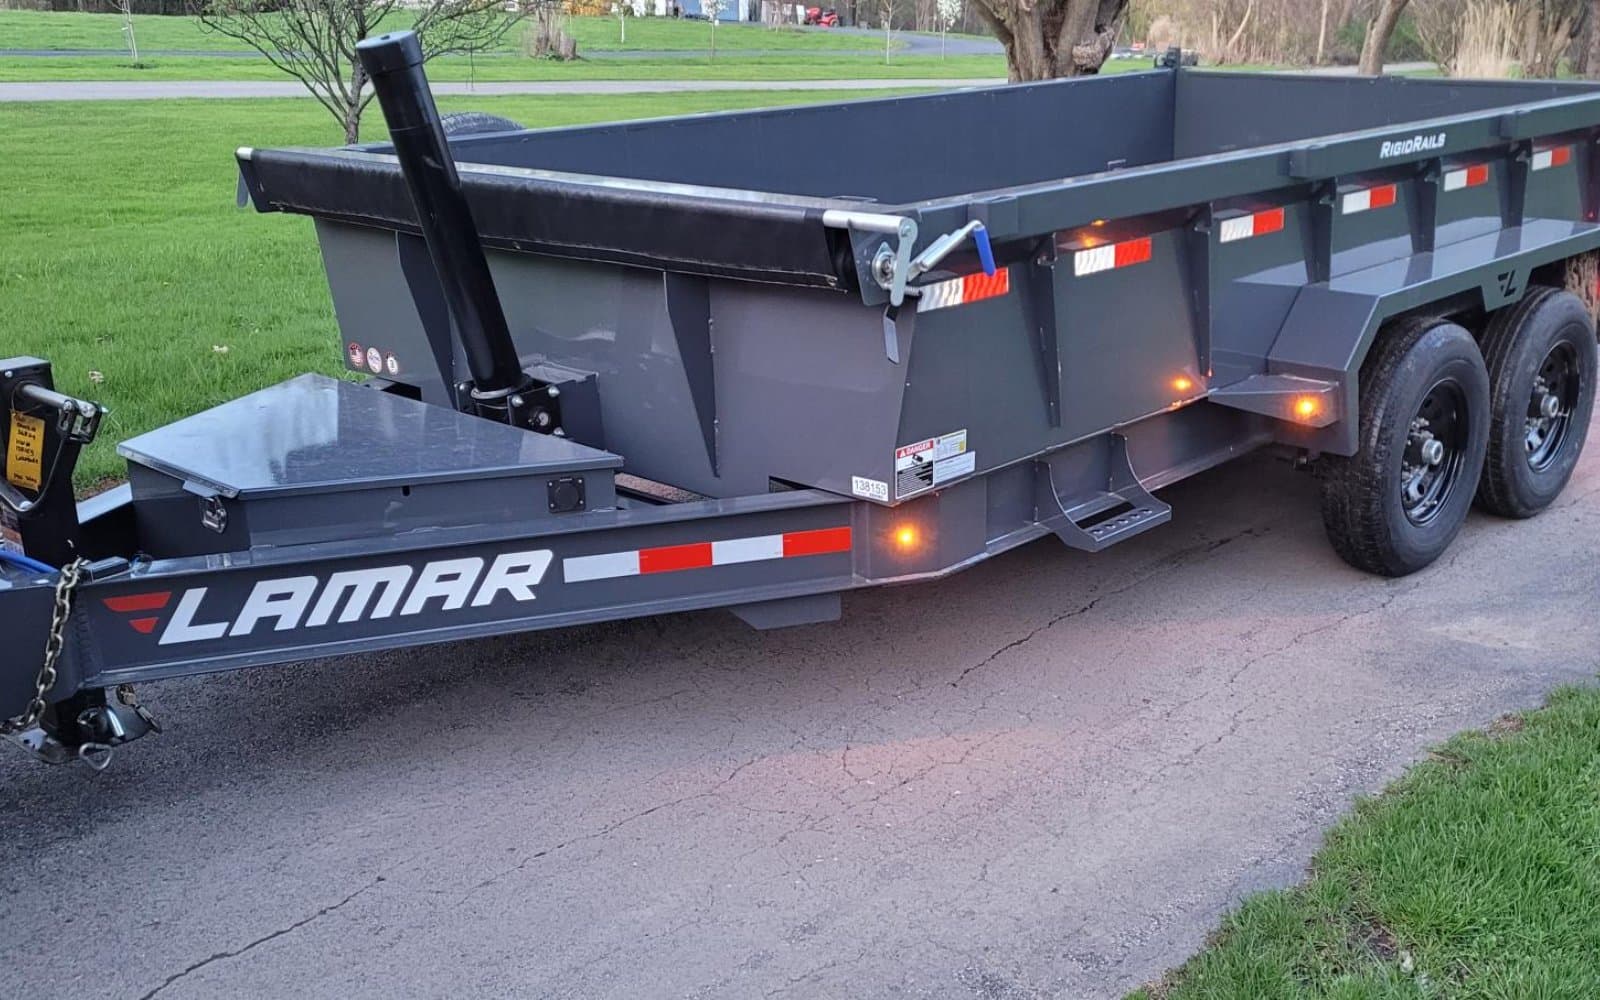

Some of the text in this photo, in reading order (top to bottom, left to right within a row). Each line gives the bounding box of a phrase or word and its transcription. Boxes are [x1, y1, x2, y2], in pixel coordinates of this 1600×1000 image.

[906, 442, 931, 454] DANGER
[854, 479, 886, 496] 138153
[158, 549, 554, 645] LAMAR
